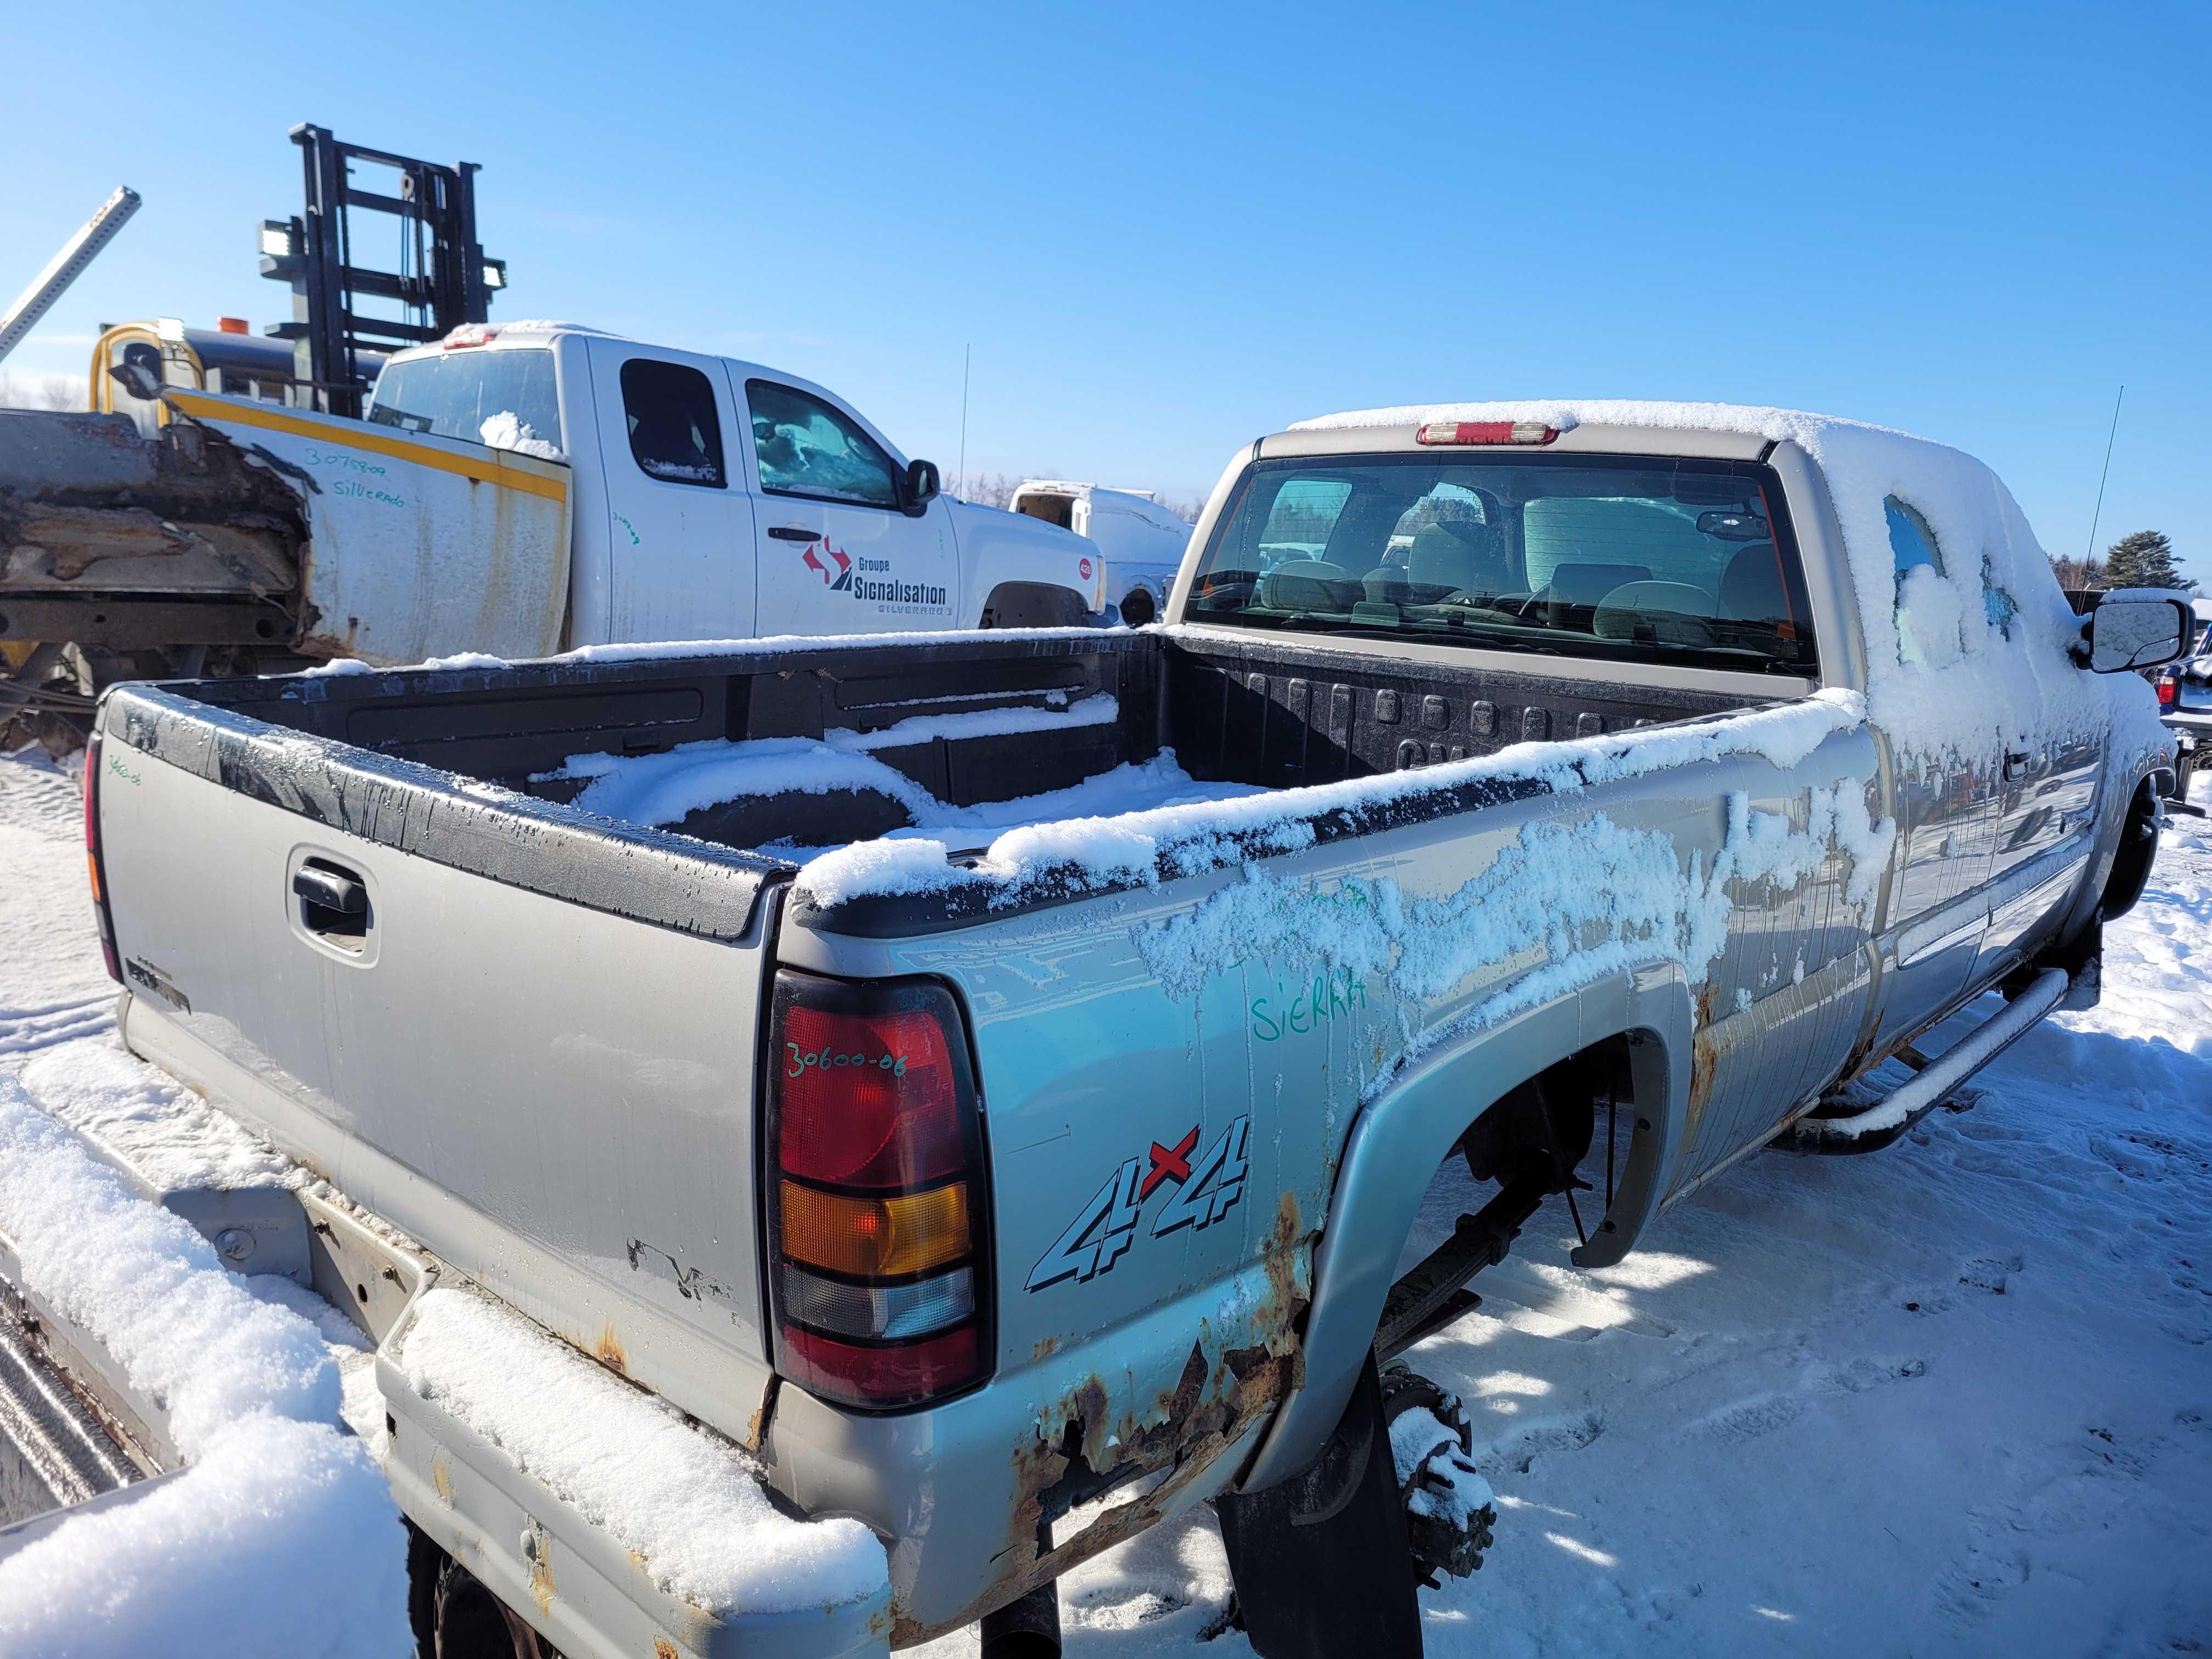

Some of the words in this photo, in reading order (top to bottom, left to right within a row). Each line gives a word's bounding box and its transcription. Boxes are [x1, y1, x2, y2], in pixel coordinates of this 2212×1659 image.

[859, 556, 890, 573] Groupe
[854, 576, 946, 605] Signalisation
[787, 1042, 908, 1077] 30600-06
